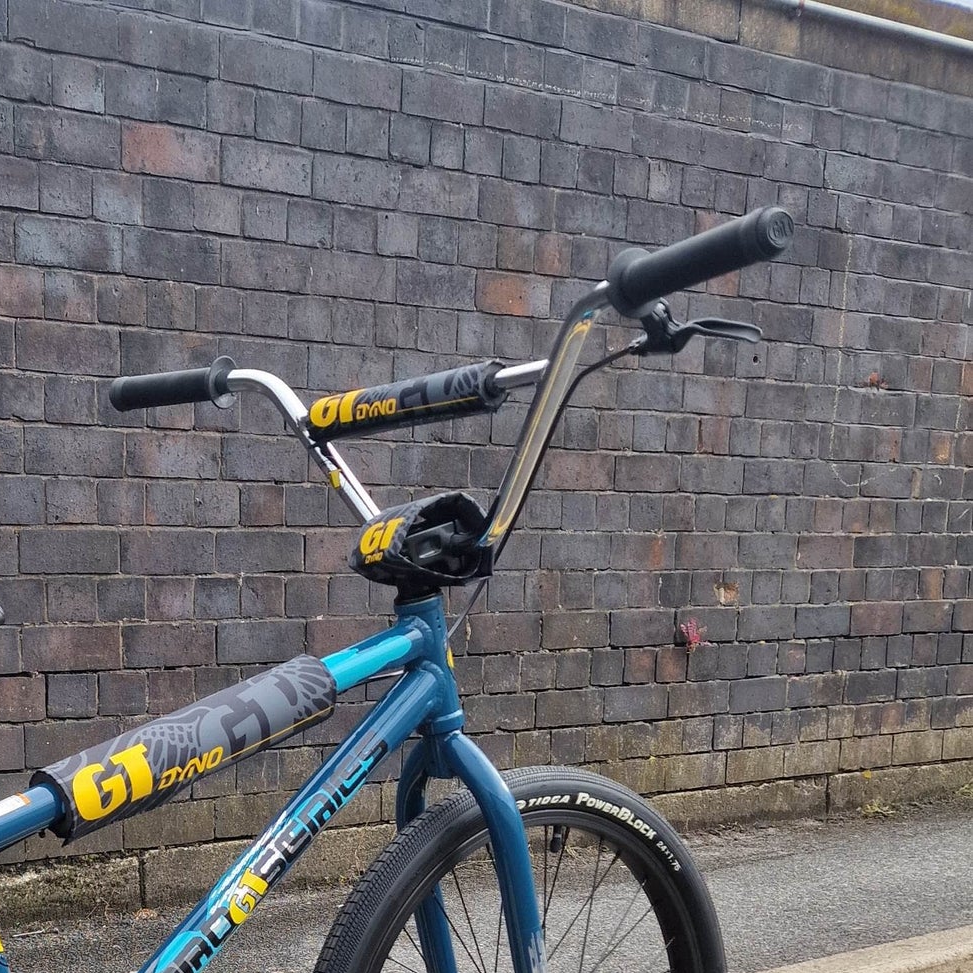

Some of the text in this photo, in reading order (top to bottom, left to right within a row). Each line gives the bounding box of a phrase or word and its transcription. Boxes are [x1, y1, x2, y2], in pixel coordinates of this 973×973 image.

[309, 388, 365, 428] GT
[355, 398, 397, 420] DYNO
[360, 517, 405, 555] GT
[72, 743, 224, 821] GT DYNO
[528, 794, 570, 808] TIOGA
[228, 867, 269, 926] GT
